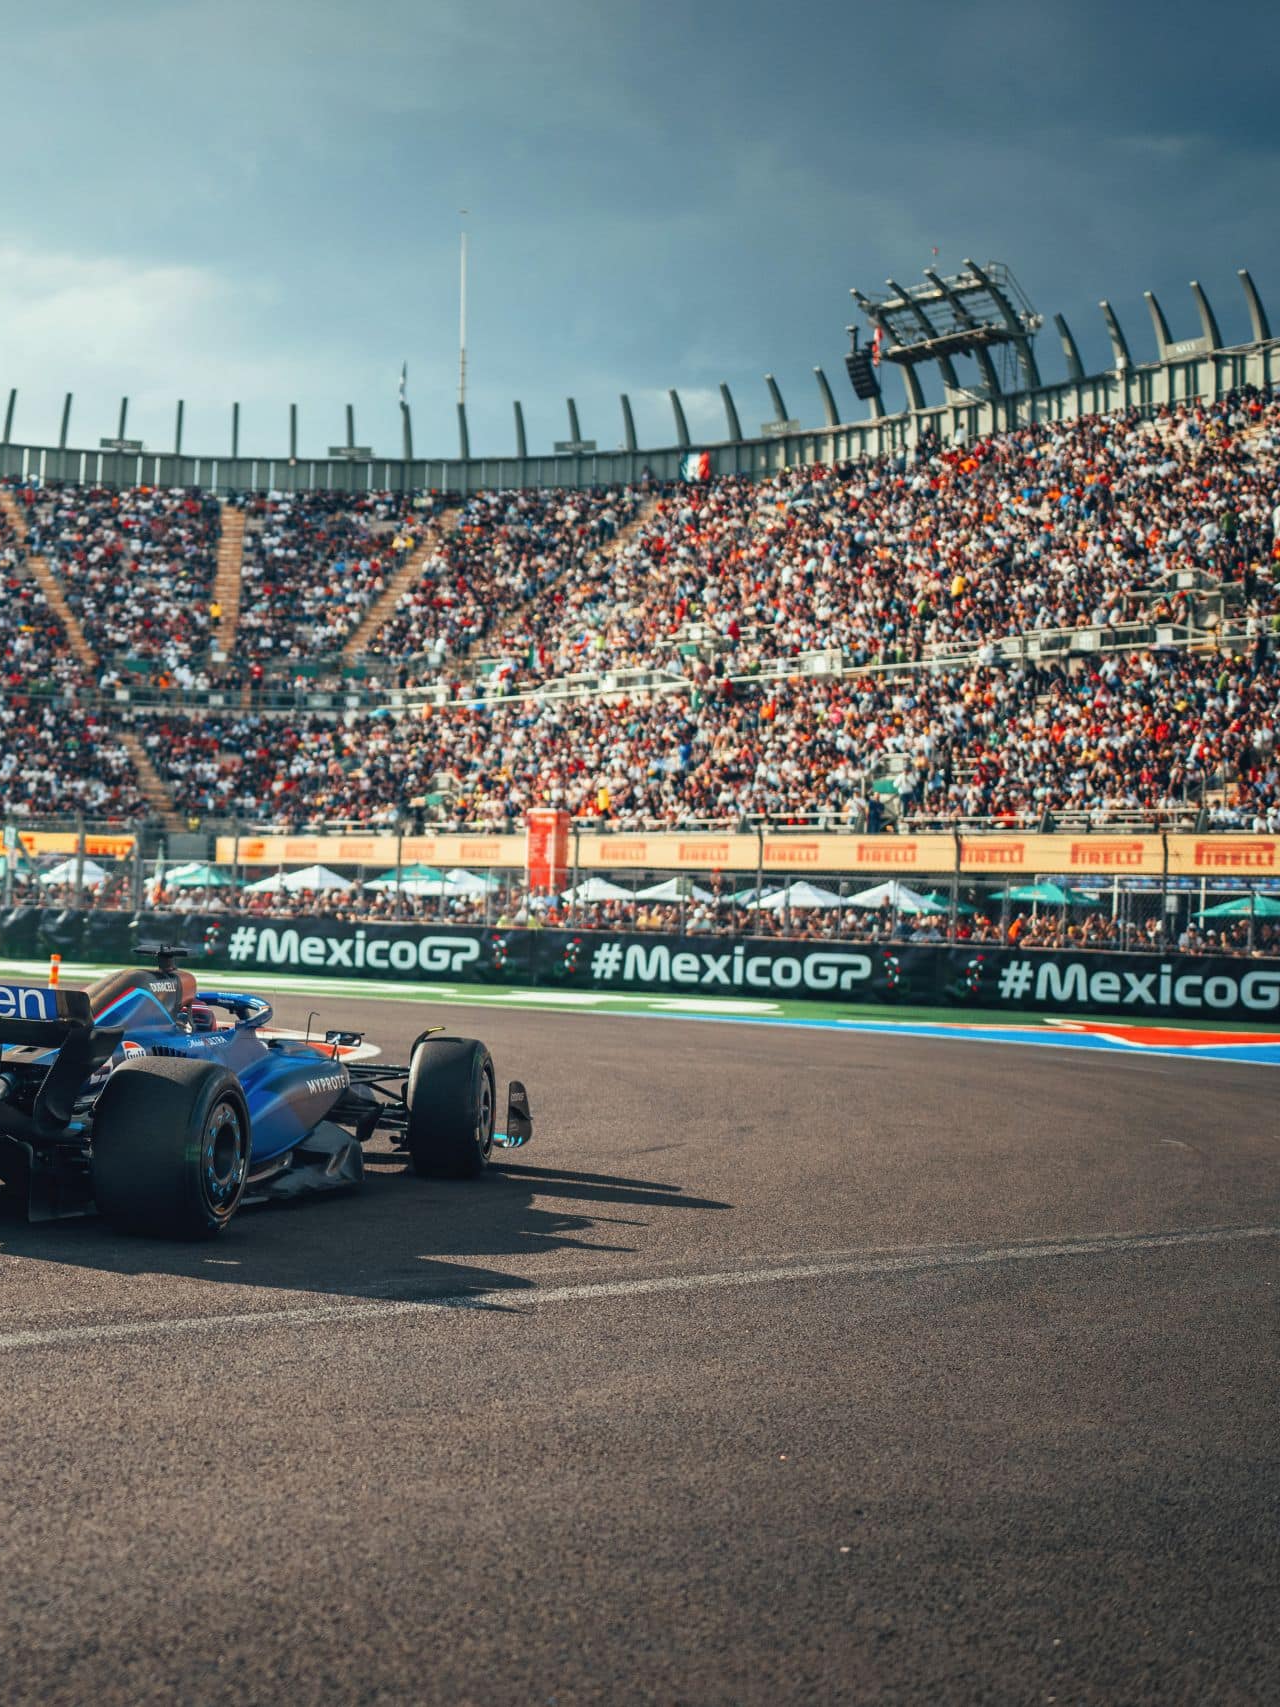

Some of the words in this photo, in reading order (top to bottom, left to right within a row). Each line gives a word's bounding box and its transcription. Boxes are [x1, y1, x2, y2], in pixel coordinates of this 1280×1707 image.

[857, 843, 918, 862] PIRELLI
[1071, 843, 1144, 865] PIRELLI
[1195, 842, 1276, 866] PIRELLI
[228, 926, 480, 972] #MexicoGP
[590, 942, 872, 990] #MexicoGP
[998, 960, 1280, 1010] #MexicoG
